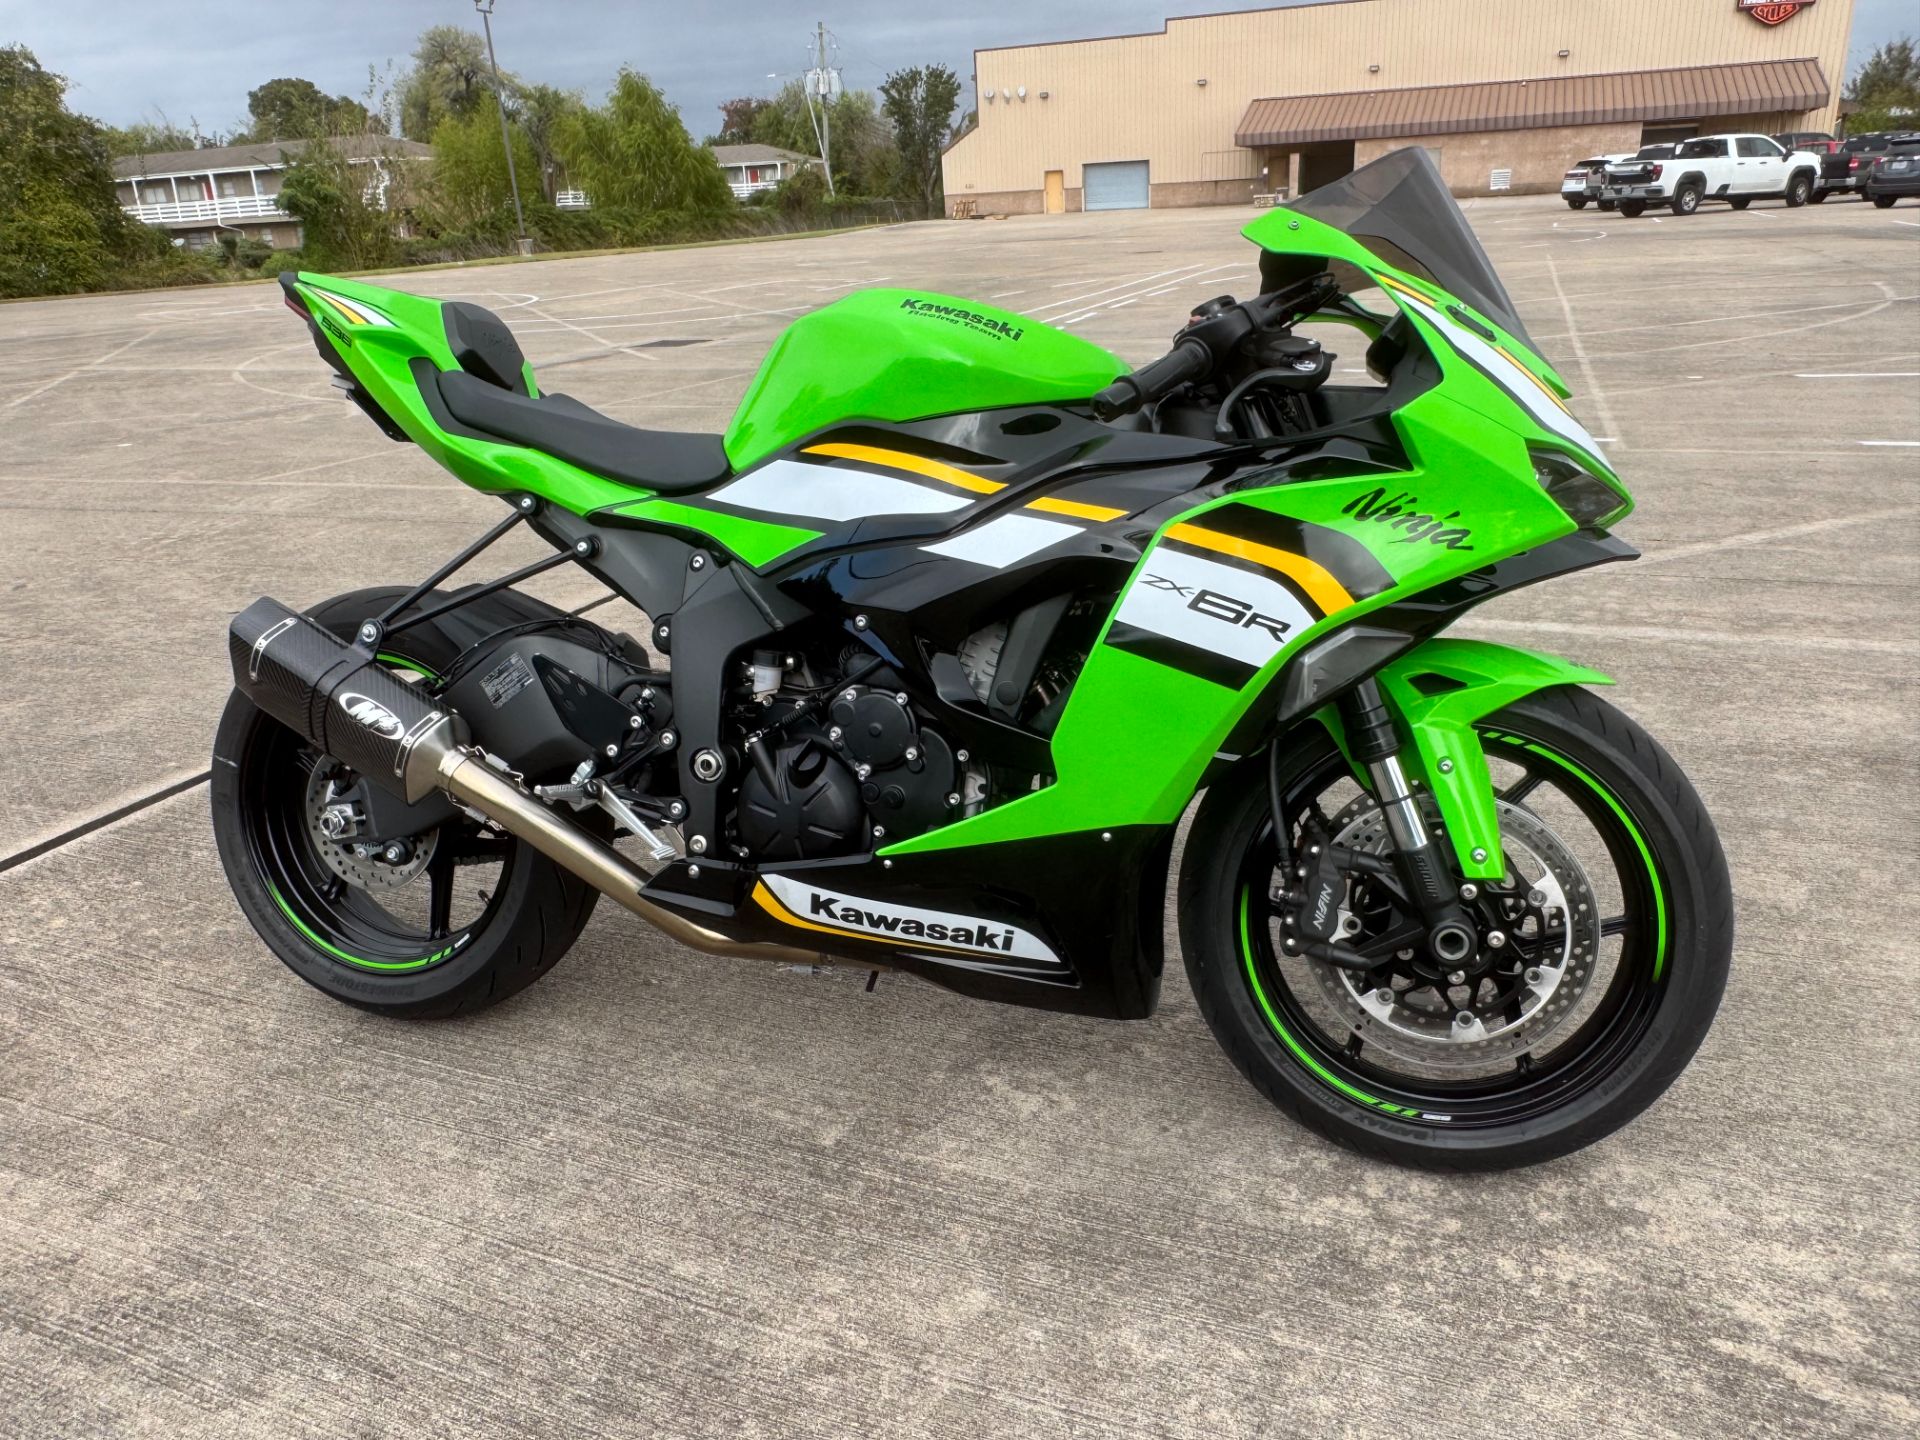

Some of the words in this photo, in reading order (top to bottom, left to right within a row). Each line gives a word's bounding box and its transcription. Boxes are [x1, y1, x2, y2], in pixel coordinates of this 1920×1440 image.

[1757, 4, 1794, 20] CYCLES
[900, 299, 1024, 342] Kawasaki
[907, 310, 960, 325] Racing
[964, 321, 1002, 341] Team
[1341, 487, 1474, 551] Ninja
[810, 892, 1015, 952] Kawasaki
